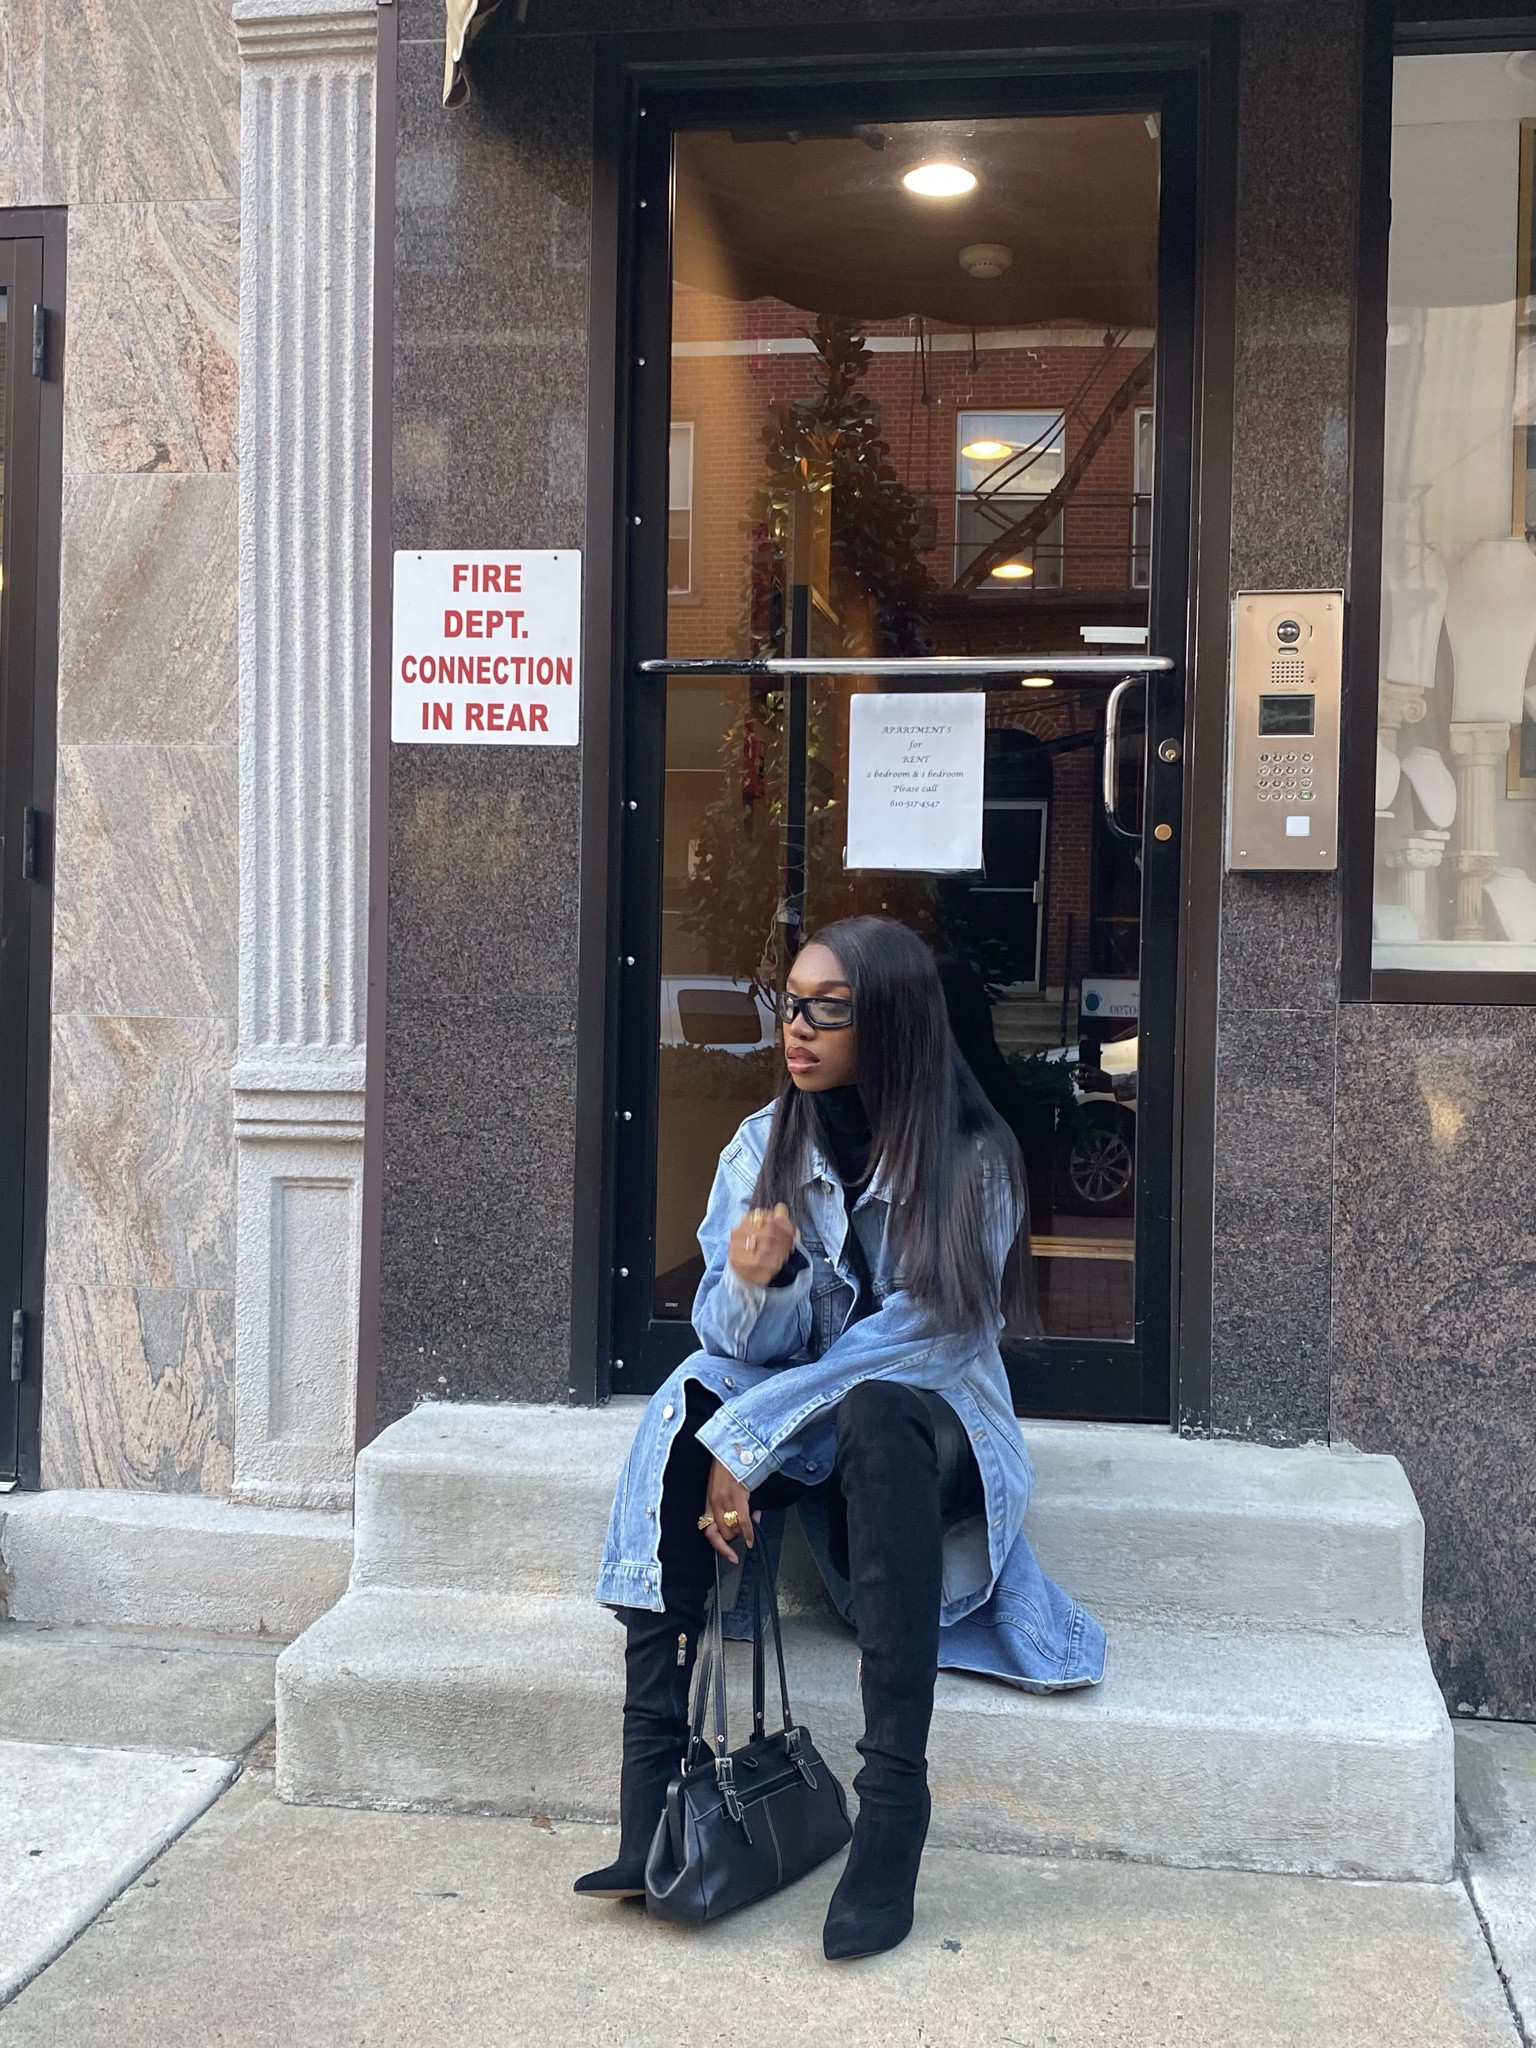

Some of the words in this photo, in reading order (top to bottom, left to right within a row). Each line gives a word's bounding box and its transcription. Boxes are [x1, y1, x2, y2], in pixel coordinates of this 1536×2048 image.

[452, 564, 522, 593] FIRE
[444, 610, 529, 638] DEPT.
[401, 655, 573, 686] CONNECTION
[422, 702, 453, 731] IN
[465, 703, 549, 732] REAR
[907, 740, 923, 751] for
[902, 755, 931, 764] RENT
[873, 769, 911, 779] bedroom
[912, 770, 920, 779] &
[921, 771, 926, 779] 1
[927, 768, 965, 779] bedroom
[892, 784, 920, 793] Please
[921, 783, 940, 793] call
[889, 799, 941, 809] 610-517-4547
